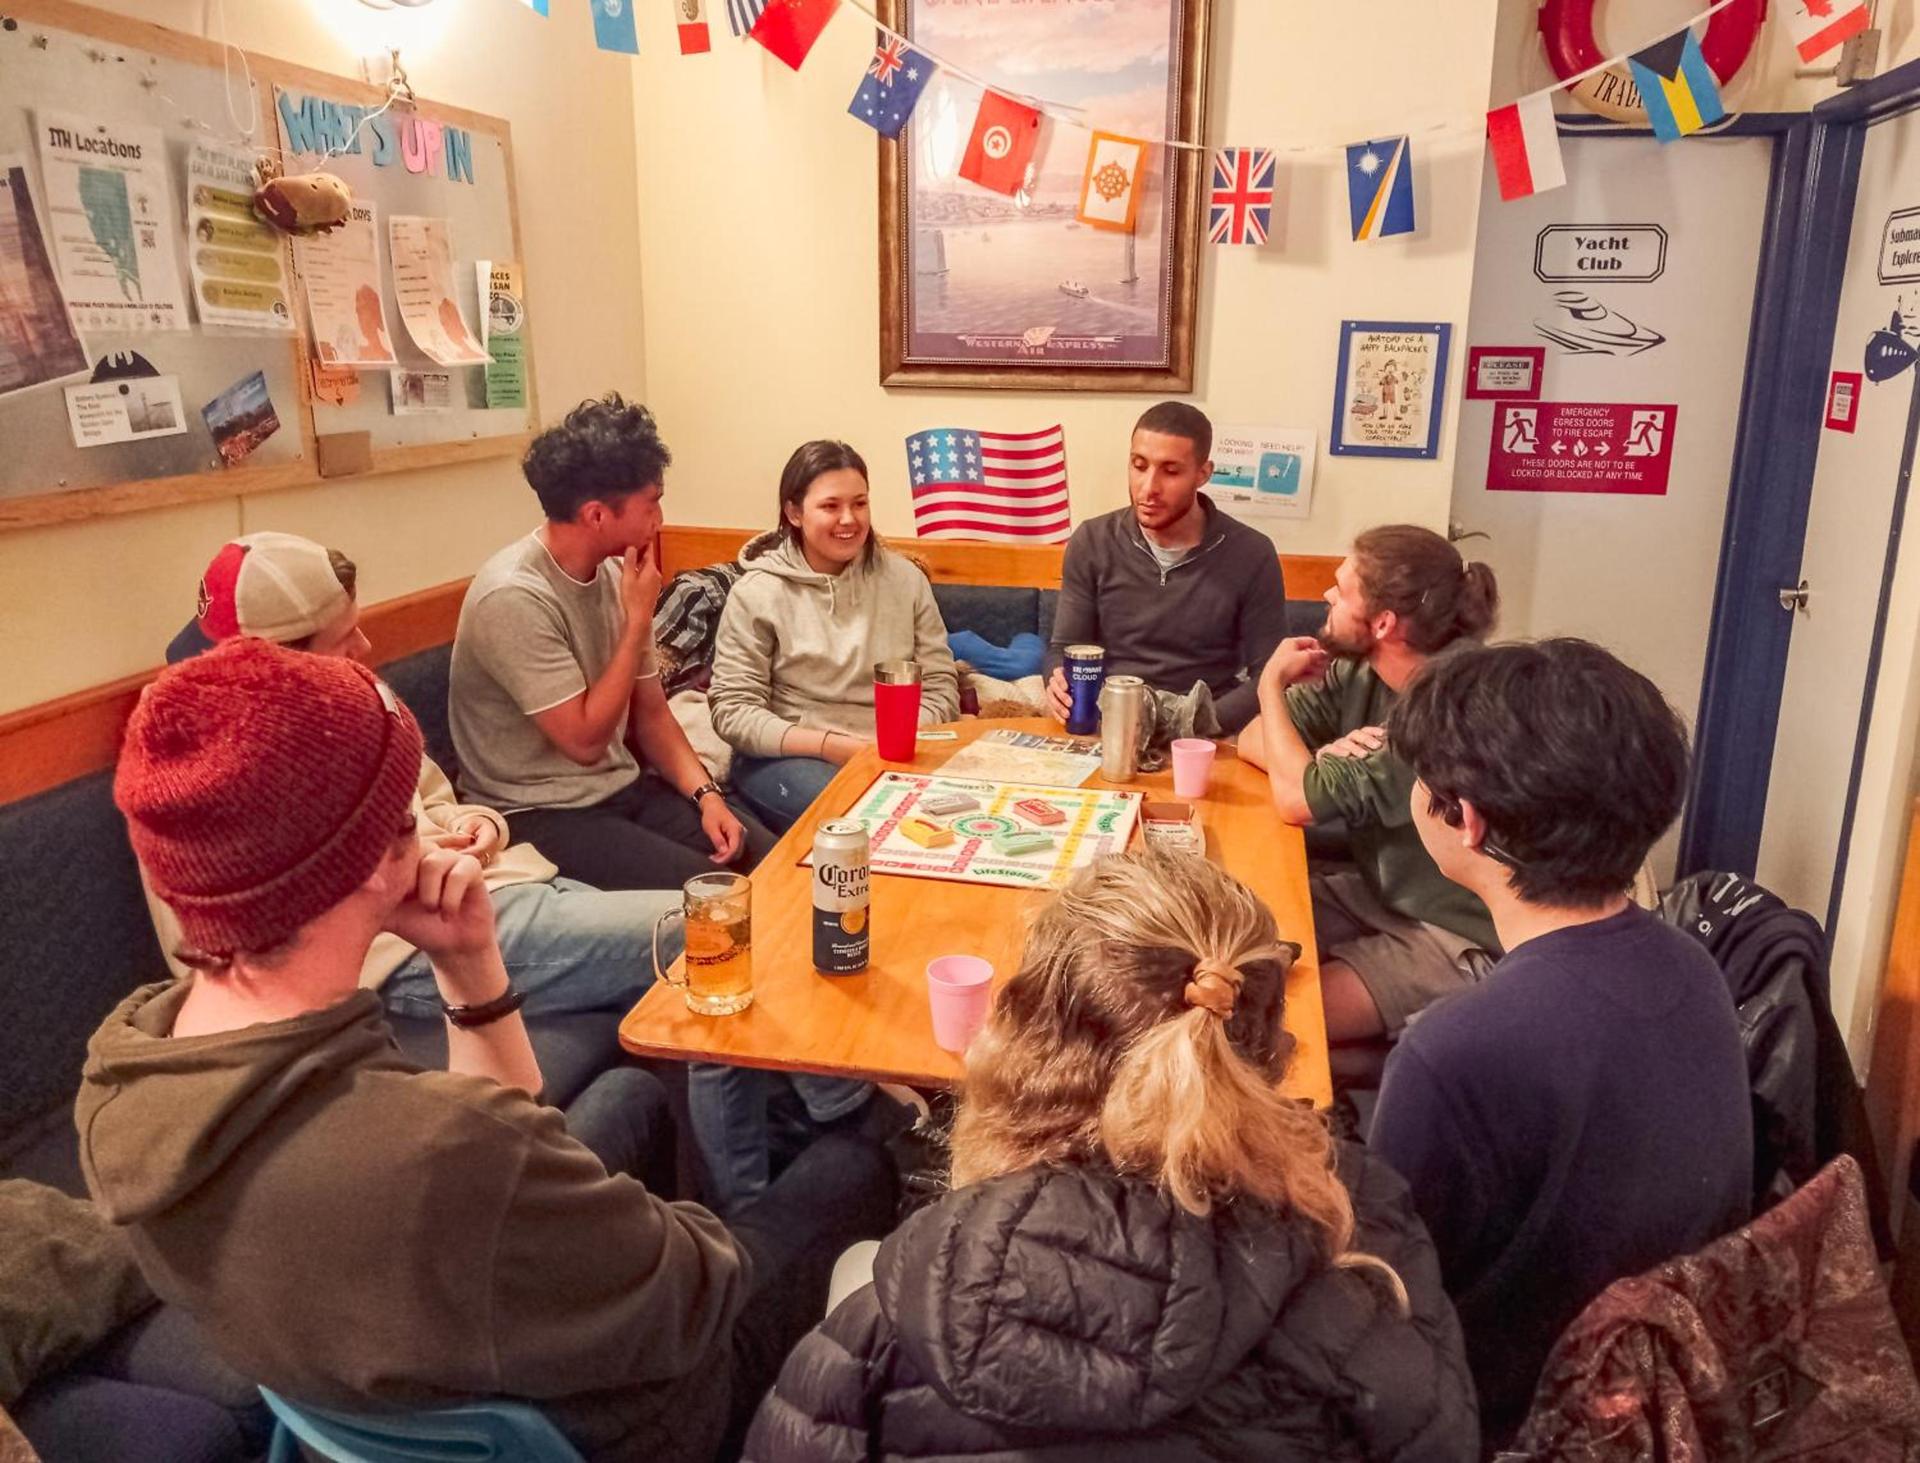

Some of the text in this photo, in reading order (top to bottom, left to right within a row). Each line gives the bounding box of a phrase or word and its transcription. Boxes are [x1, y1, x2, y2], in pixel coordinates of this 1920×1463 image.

[75, 133, 142, 159] Locations
[401, 118, 443, 177] UP
[444, 125, 474, 185] IN
[352, 207, 372, 222] DAYS
[1575, 236, 1630, 250] Yacht
[1577, 256, 1622, 271] Club
[490, 272, 511, 281] ACES
[493, 282, 511, 291] SAN
[966, 338, 1021, 348] WESTERN
[1046, 340, 1104, 349] EXPRESS
[1561, 408, 1610, 416] EMERGENCY
[1553, 418, 1614, 427] EGRESS DOORS
[1552, 428, 1613, 437] TO FIRE ESCAPE
[1522, 459, 1635, 469] THESE DOORS ARE NOT TO BE
[1512, 469, 1643, 480] LOCKED OR BLOCKED AT ANY TIME
